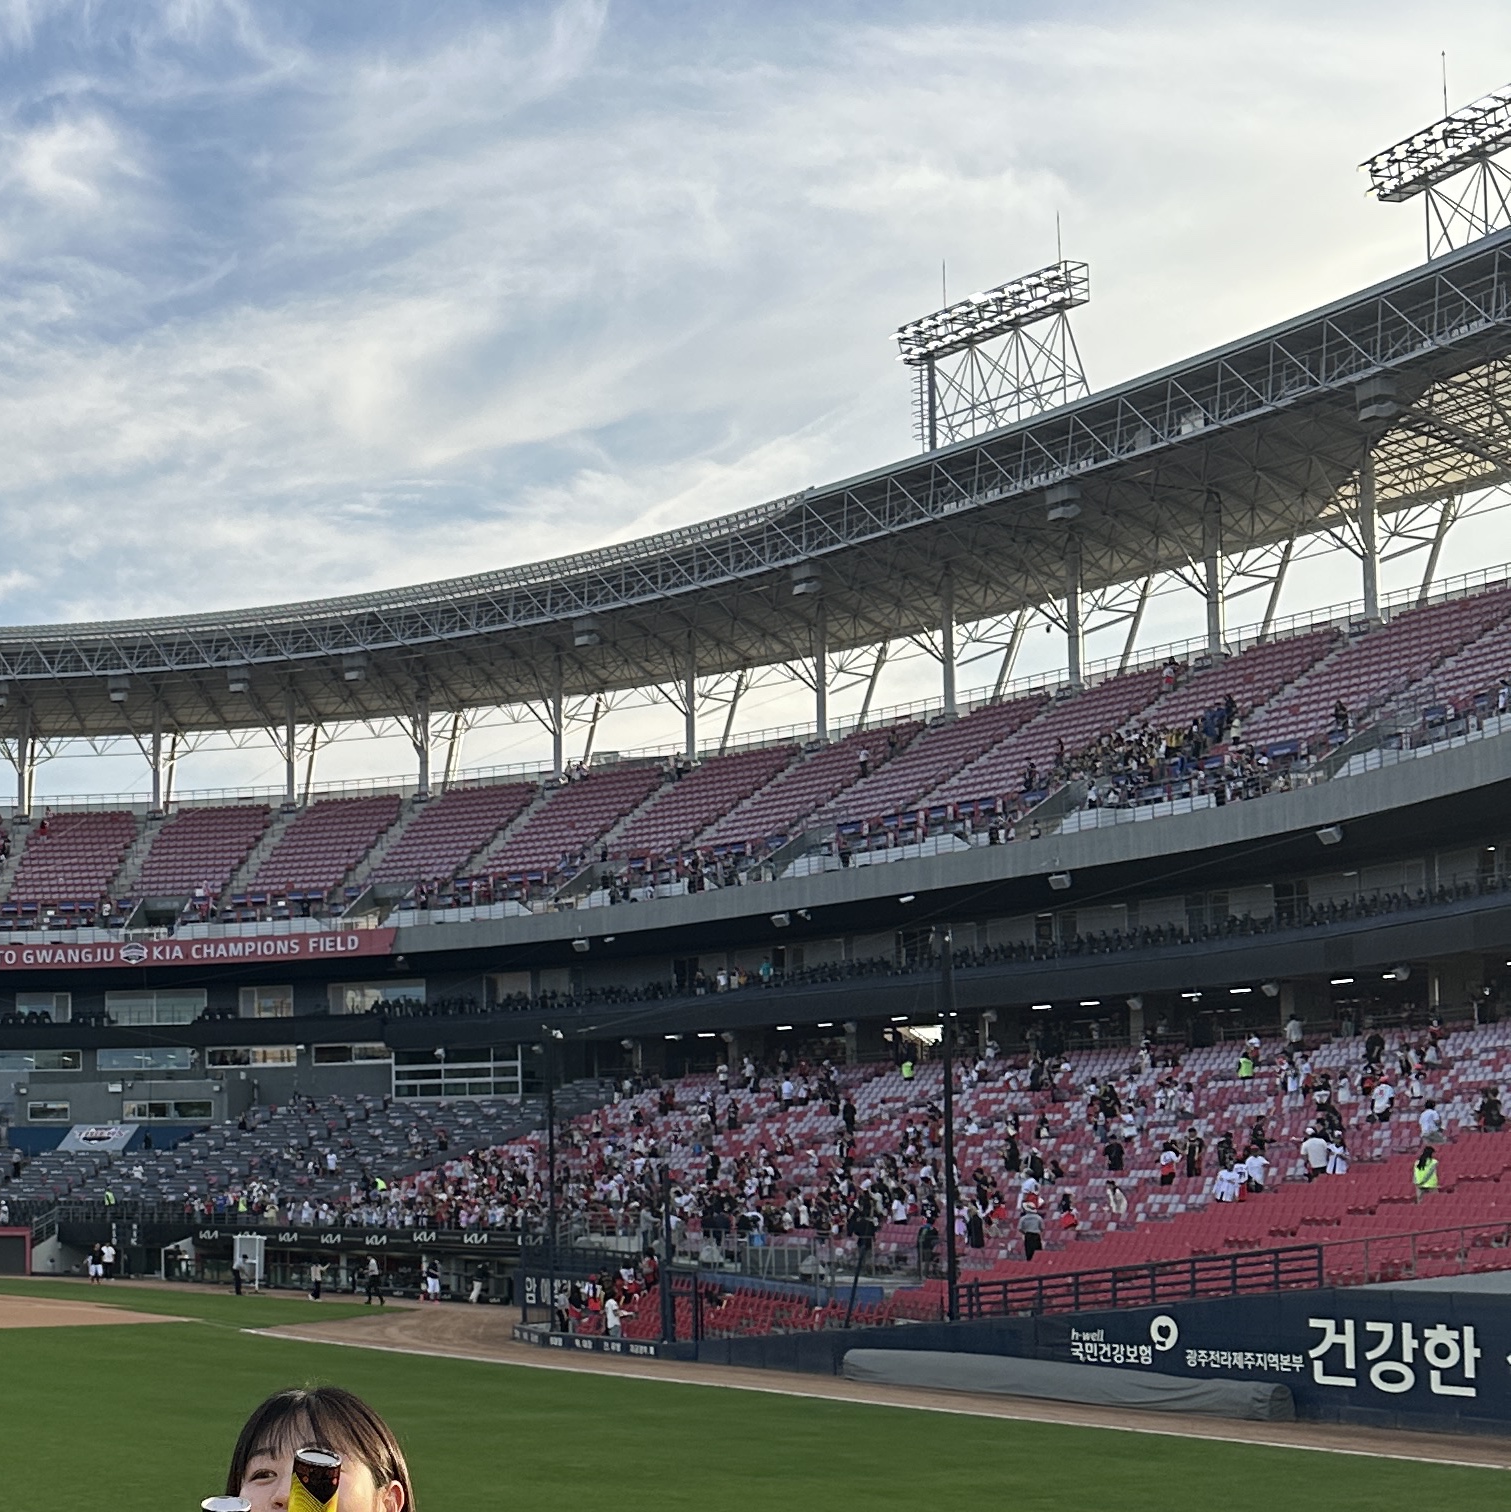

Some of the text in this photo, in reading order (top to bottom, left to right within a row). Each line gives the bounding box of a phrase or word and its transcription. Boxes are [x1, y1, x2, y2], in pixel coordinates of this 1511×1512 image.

[22, 947, 115, 965] GWANGJU
[152, 945, 184, 961] KIA
[191, 938, 300, 960] CHAMPIONS
[308, 935, 359, 953] FIELD
[199, 1230, 219, 1240] KIA
[278, 1232, 298, 1242] KIA
[321, 1233, 341, 1244] KIA
[365, 1234, 388, 1246] KIA
[413, 1231, 436, 1242] KIA
[463, 1232, 488, 1245] KIA
[1071, 1328, 1105, 1342] h-well
[1070, 1341, 1305, 1372] 국민건강보험 광주전라제주지역본부
[1308, 1317, 1482, 1398] 건강한
